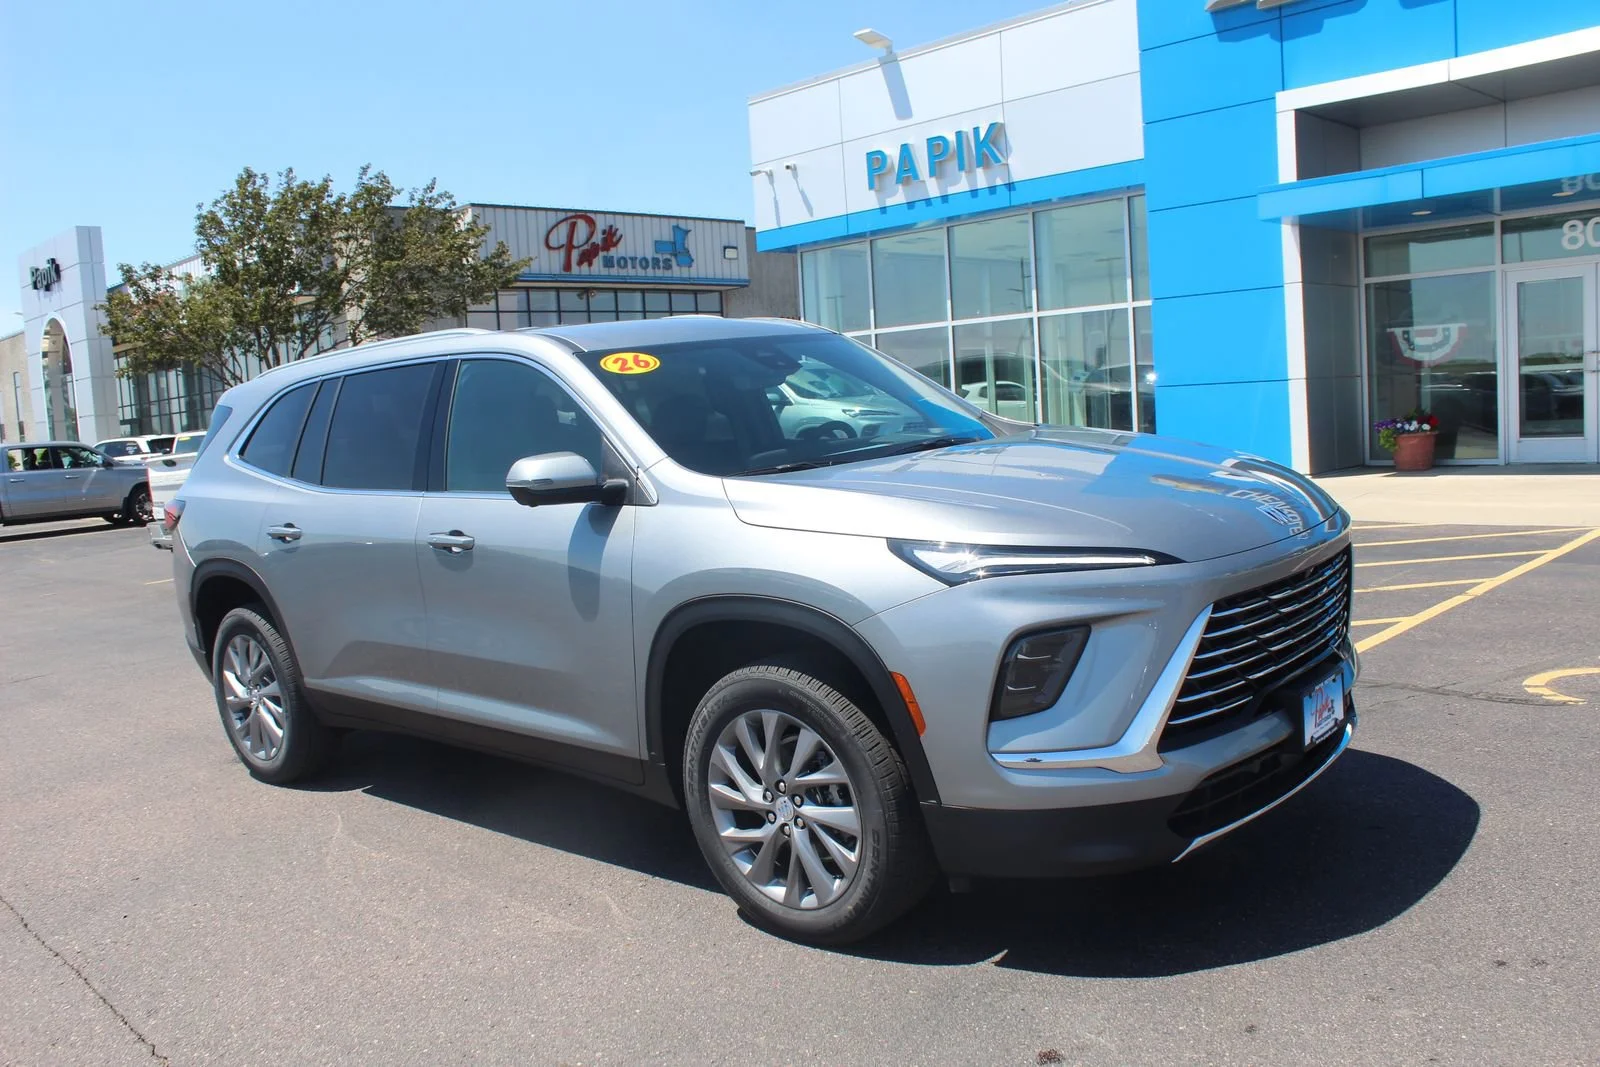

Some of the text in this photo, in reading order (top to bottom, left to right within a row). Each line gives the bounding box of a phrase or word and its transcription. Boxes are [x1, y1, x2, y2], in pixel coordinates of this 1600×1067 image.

[866, 122, 1003, 191] PAPIK
[29, 258, 60, 291] Papik
[603, 255, 673, 271] MOTORS
[612, 354, 651, 372] 26
